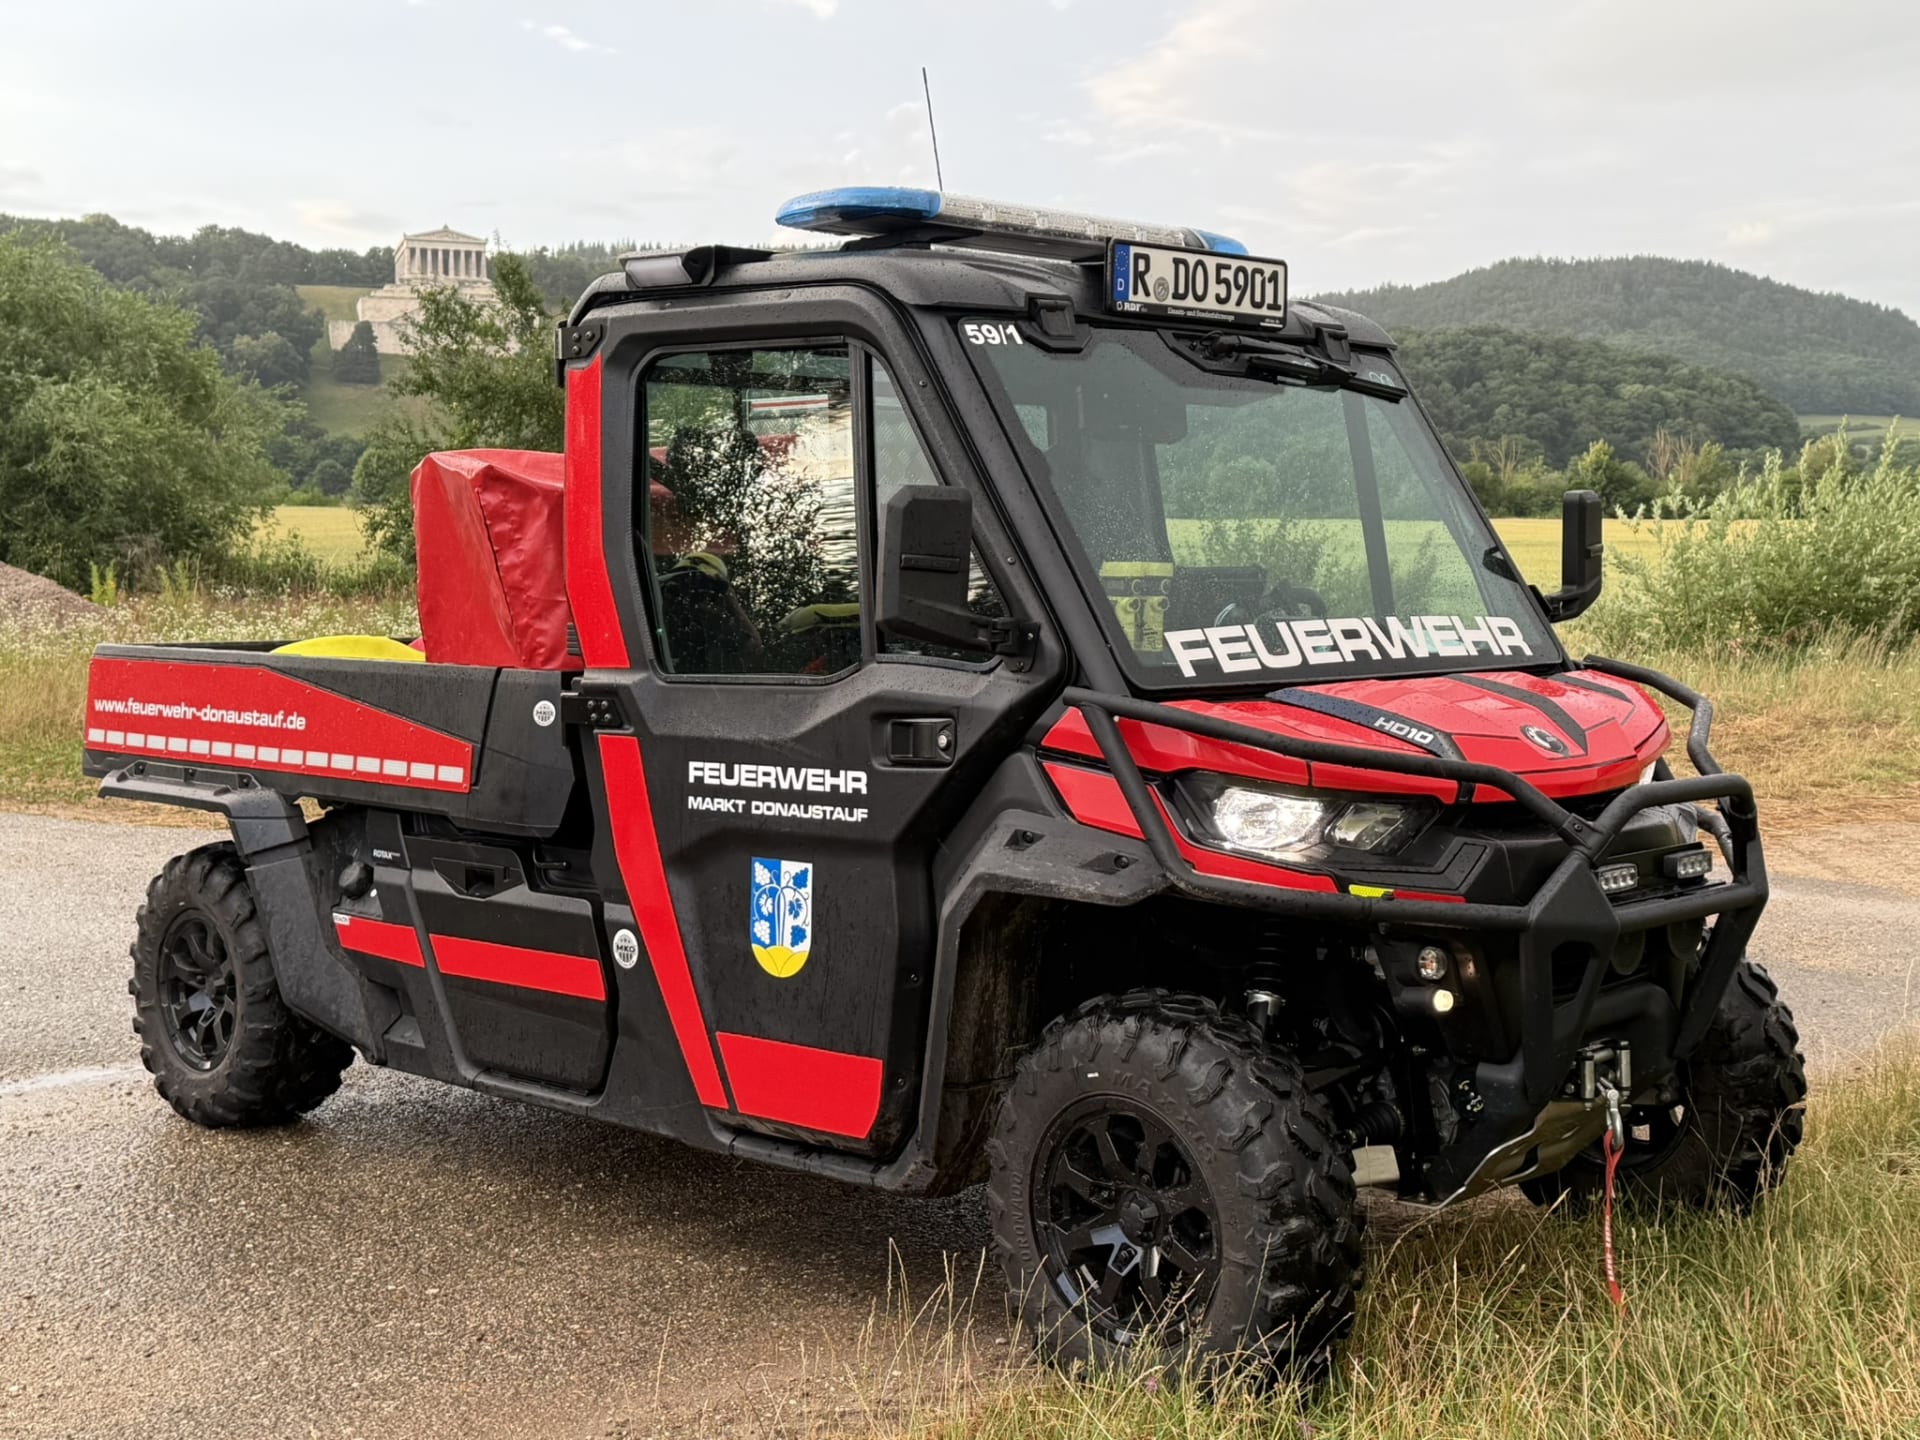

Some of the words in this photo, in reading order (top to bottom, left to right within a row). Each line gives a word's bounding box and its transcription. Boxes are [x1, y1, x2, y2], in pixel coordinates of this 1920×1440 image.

[1117, 279, 1125, 291] D
[1132, 252, 1150, 297] R
[1172, 257, 1209, 302] DO
[1214, 262, 1282, 311] 5901
[964, 322, 1023, 346] 59/1
[1164, 615, 1533, 677] FEUERWEHR
[94, 697, 306, 730] www.feuerwehr-donaustauf.de
[1374, 716, 1434, 746] HD10
[688, 761, 868, 794] FEUERWEHR
[688, 796, 747, 814] MARKT
[751, 800, 869, 823] DONAUSTAUF
